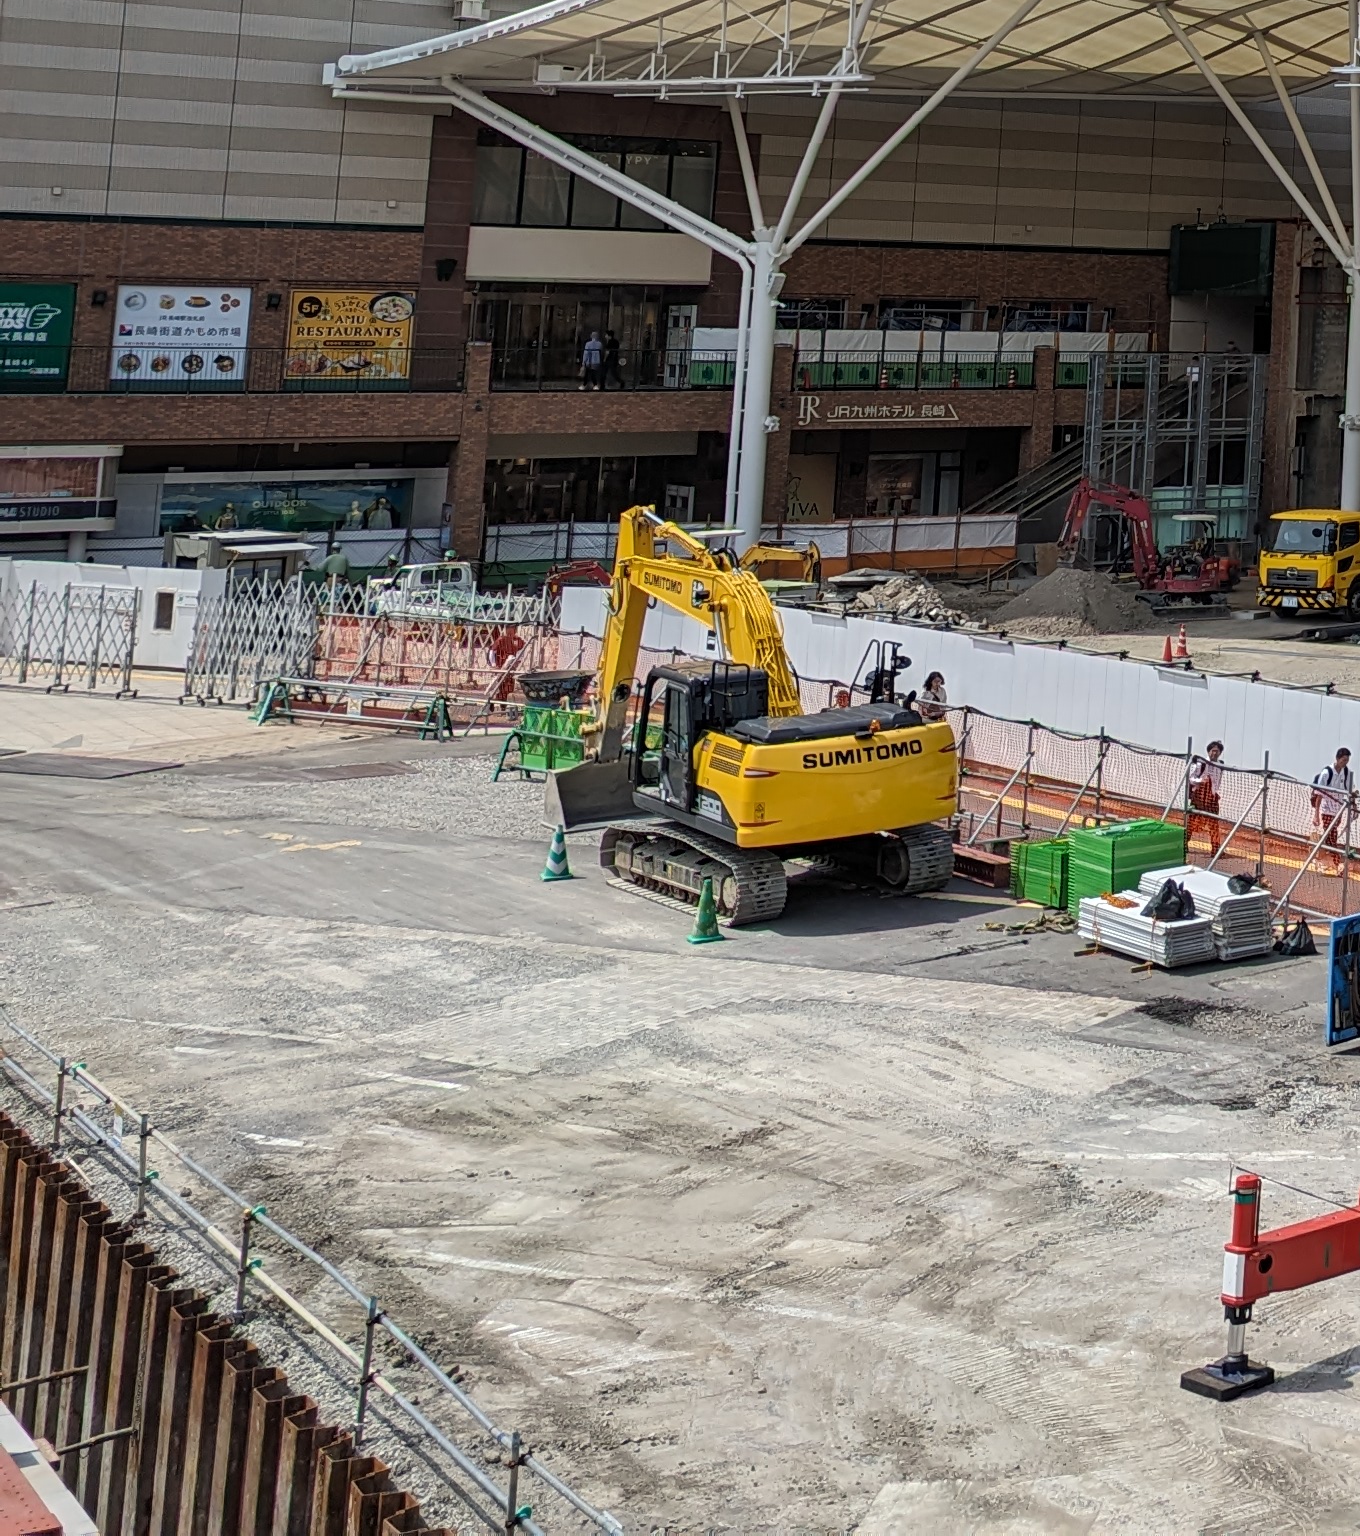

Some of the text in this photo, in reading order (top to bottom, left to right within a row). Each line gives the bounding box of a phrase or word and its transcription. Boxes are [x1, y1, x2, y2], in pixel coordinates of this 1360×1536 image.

[301, 302, 320, 313] 5F
[334, 315, 366, 325] AMU
[135, 325, 241, 337] 長崎街道かもめ市場
[296, 326, 403, 337] RESTAURANTS
[827, 405, 946, 418] JR九州ホテル 長崎
[19, 505, 60, 517] STUDIO
[786, 502, 819, 516] IVA
[644, 571, 683, 595] SUMITOMO
[802, 739, 923, 770] SUMITOMO
